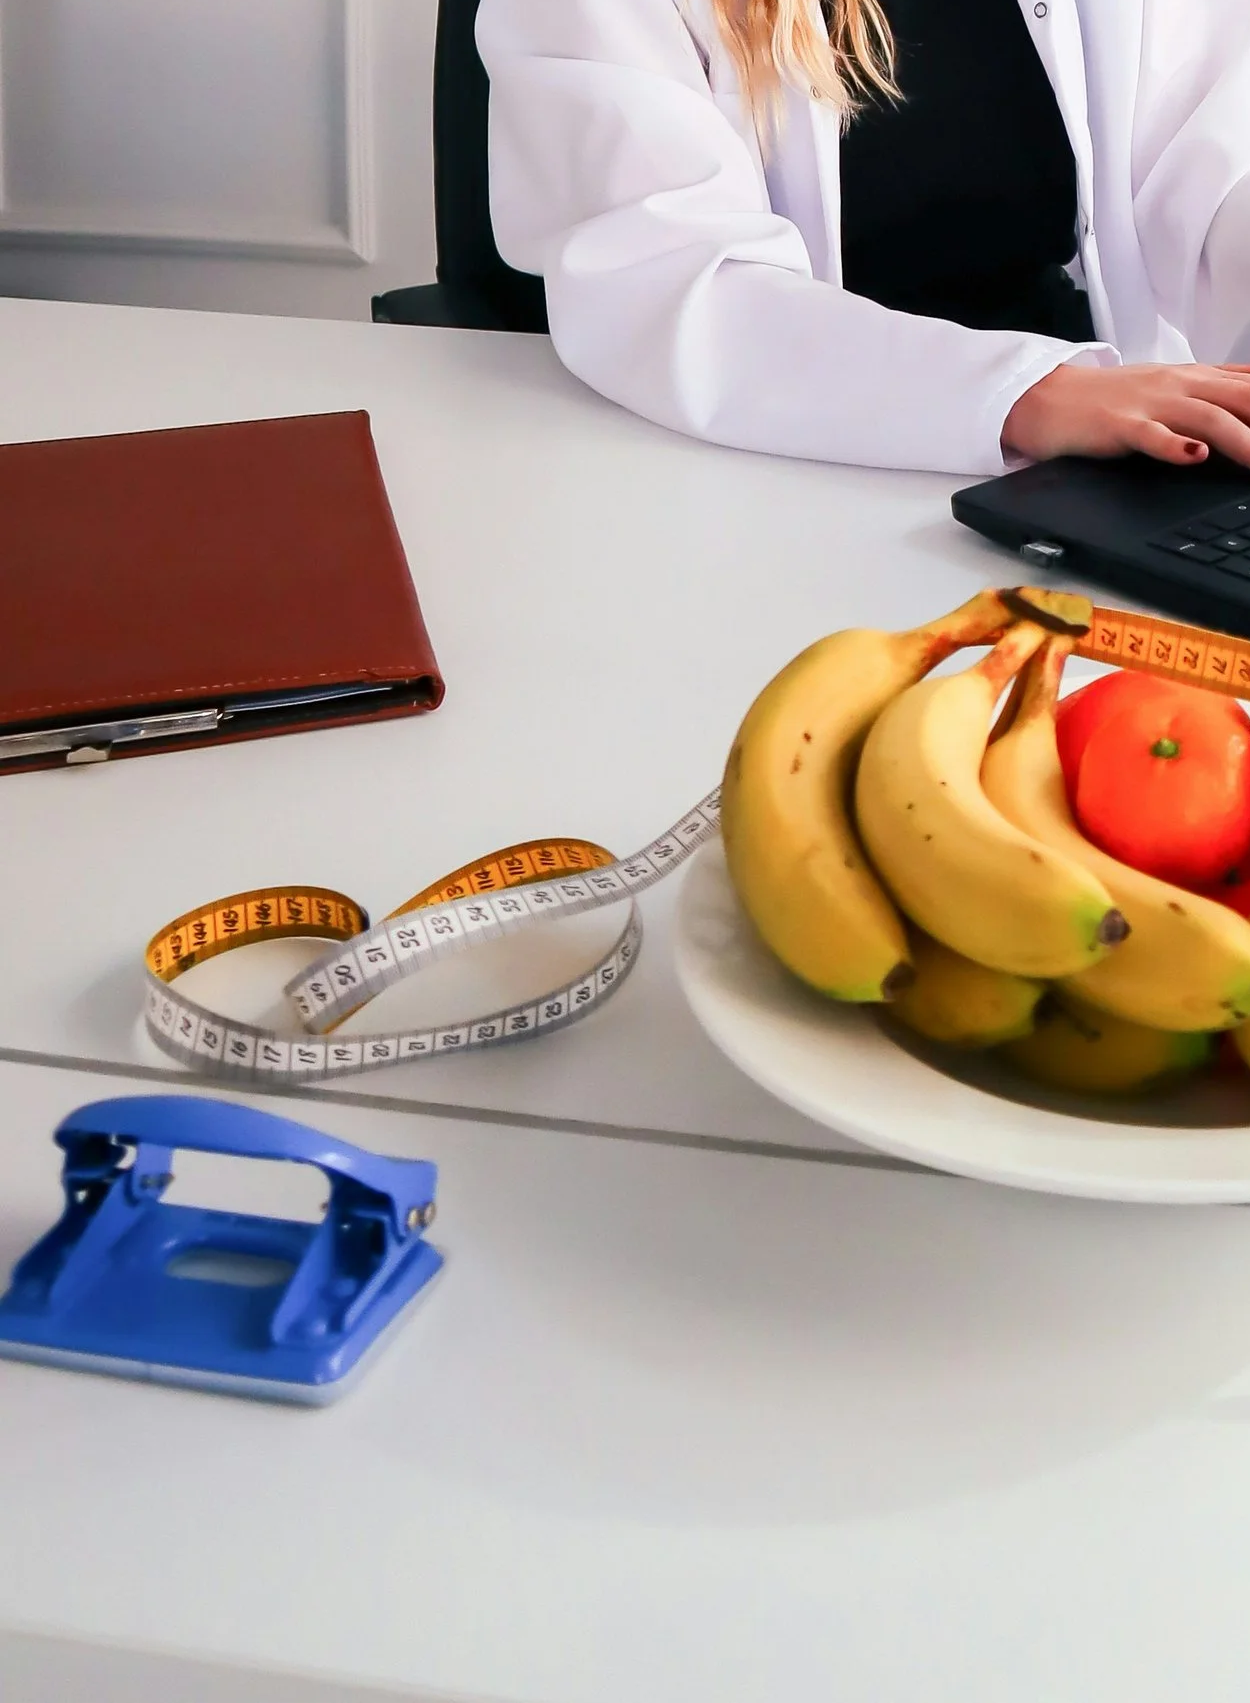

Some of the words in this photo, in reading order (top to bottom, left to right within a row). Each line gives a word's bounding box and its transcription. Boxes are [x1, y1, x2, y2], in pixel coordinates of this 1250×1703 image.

[475, 869, 495, 890] 114
[506, 856, 525, 877] 115
[539, 849, 555, 866] 116
[193, 921, 208, 947] 144
[223, 908, 239, 933] 145
[255, 900, 272, 926] 146
[286, 897, 305, 923] 147
[335, 965, 356, 986] 50
[365, 947, 387, 962] 51
[396, 929, 420, 948] 52
[431, 916, 454, 934] 53
[467, 904, 488, 922] 54
[500, 898, 521, 913] 55
[534, 891, 552, 904] 56
[561, 883, 584, 896] 57
[591, 877, 615, 888] 58
[203, 1029, 217, 1048] 15
[230, 1040, 247, 1058] 16
[263, 1045, 281, 1063] 17
[299, 1048, 317, 1064] 18
[333, 1049, 352, 1061] 19
[477, 1025, 496, 1038] 23
[511, 1016, 529, 1030] 24
